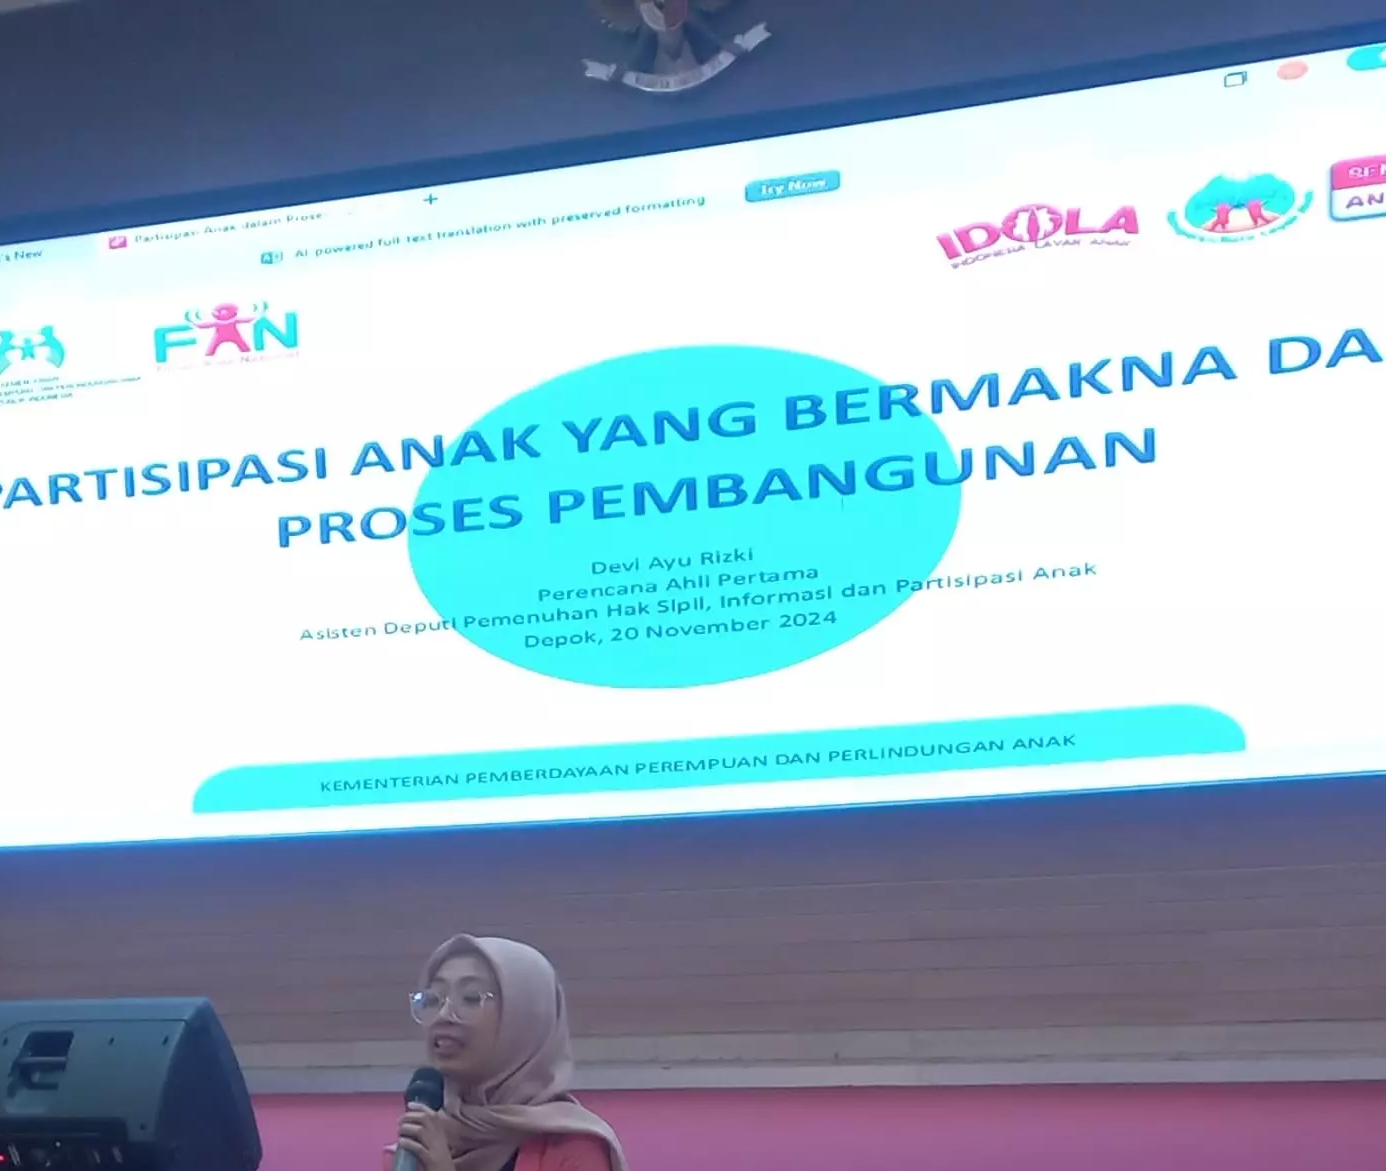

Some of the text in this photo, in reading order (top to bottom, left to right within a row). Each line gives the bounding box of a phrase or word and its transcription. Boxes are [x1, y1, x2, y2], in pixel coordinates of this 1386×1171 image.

[436, 221, 512, 240] translation
[515, 216, 547, 229] with
[551, 206, 621, 225] preserved
[625, 196, 706, 215] formatting
[935, 203, 1140, 261] IDOLA
[14, 249, 44, 261] New
[351, 423, 543, 477] ANAK
[561, 401, 757, 453] YANG
[785, 345, 1238, 432] BERMAKNA
[277, 427, 1158, 549] PROSES PEMBANGUNAN
[537, 567, 819, 602] Perencana Ahli Pertama
[591, 547, 754, 575] Devi Ayu Rizki
[299, 561, 1098, 640] Asisten Deputi Pemenuhan Hak Sipil, Informasi dan Partisipasi Anak
[524, 610, 838, 649] Depok, 20 November 2024
[319, 733, 1077, 793] KEMENTERIAN PEMBERDAYAAN PEREMPUAN DAN PERLINDUNGAN ANAK
